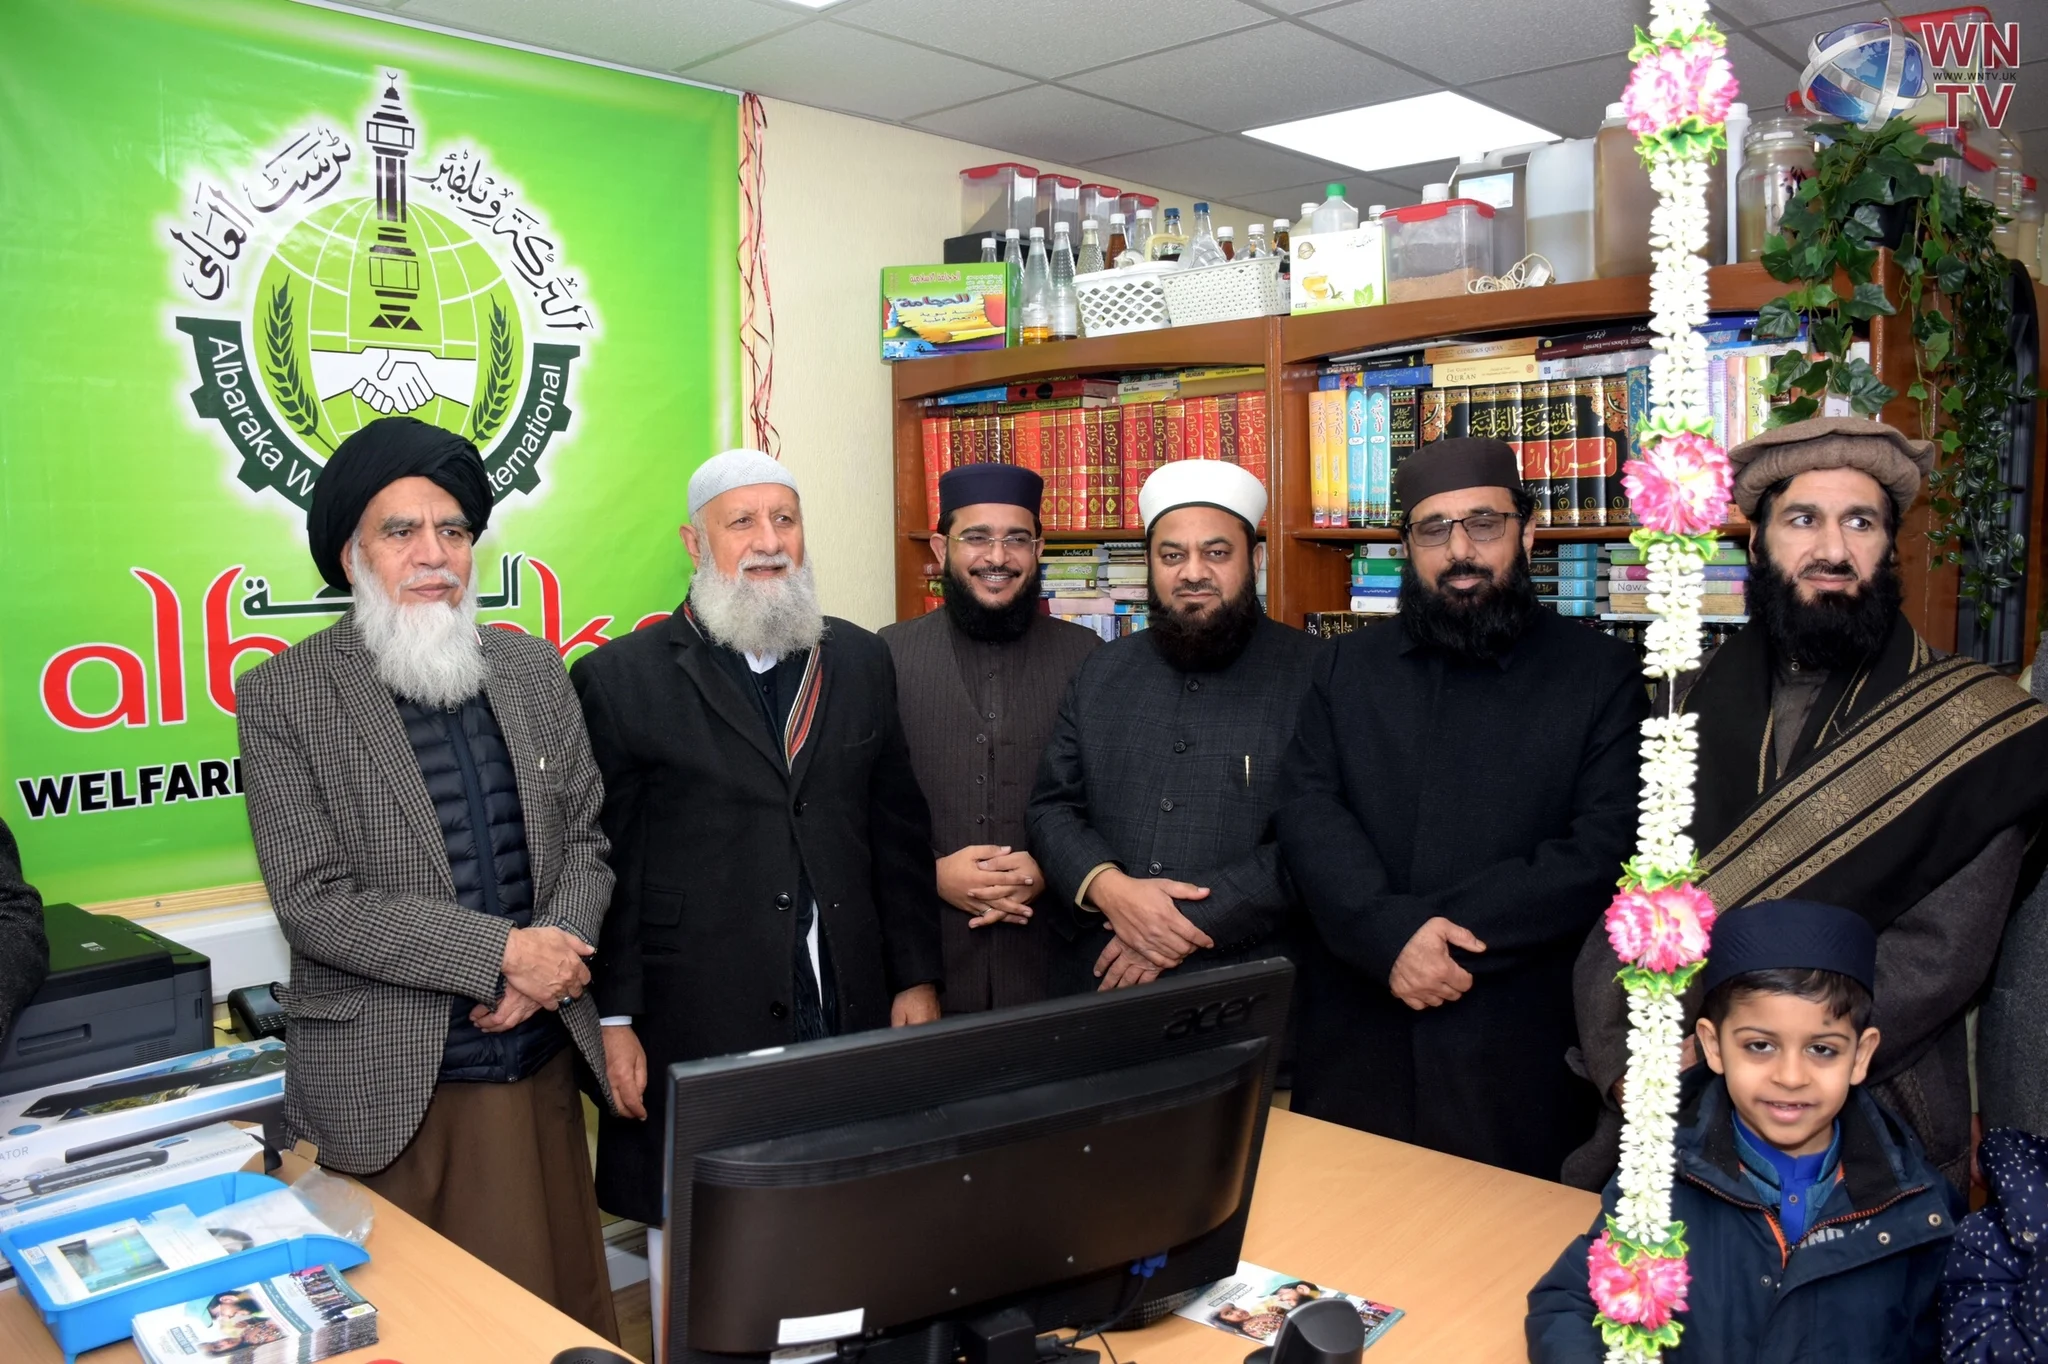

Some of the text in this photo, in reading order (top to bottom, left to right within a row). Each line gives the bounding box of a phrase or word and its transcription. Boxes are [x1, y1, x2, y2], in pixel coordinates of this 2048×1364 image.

[1326, 364, 1362, 374] DEATH?
[208, 336, 284, 472] Albaraka
[1618, 583, 1641, 592] Now
[1164, 992, 1270, 1040] acer
